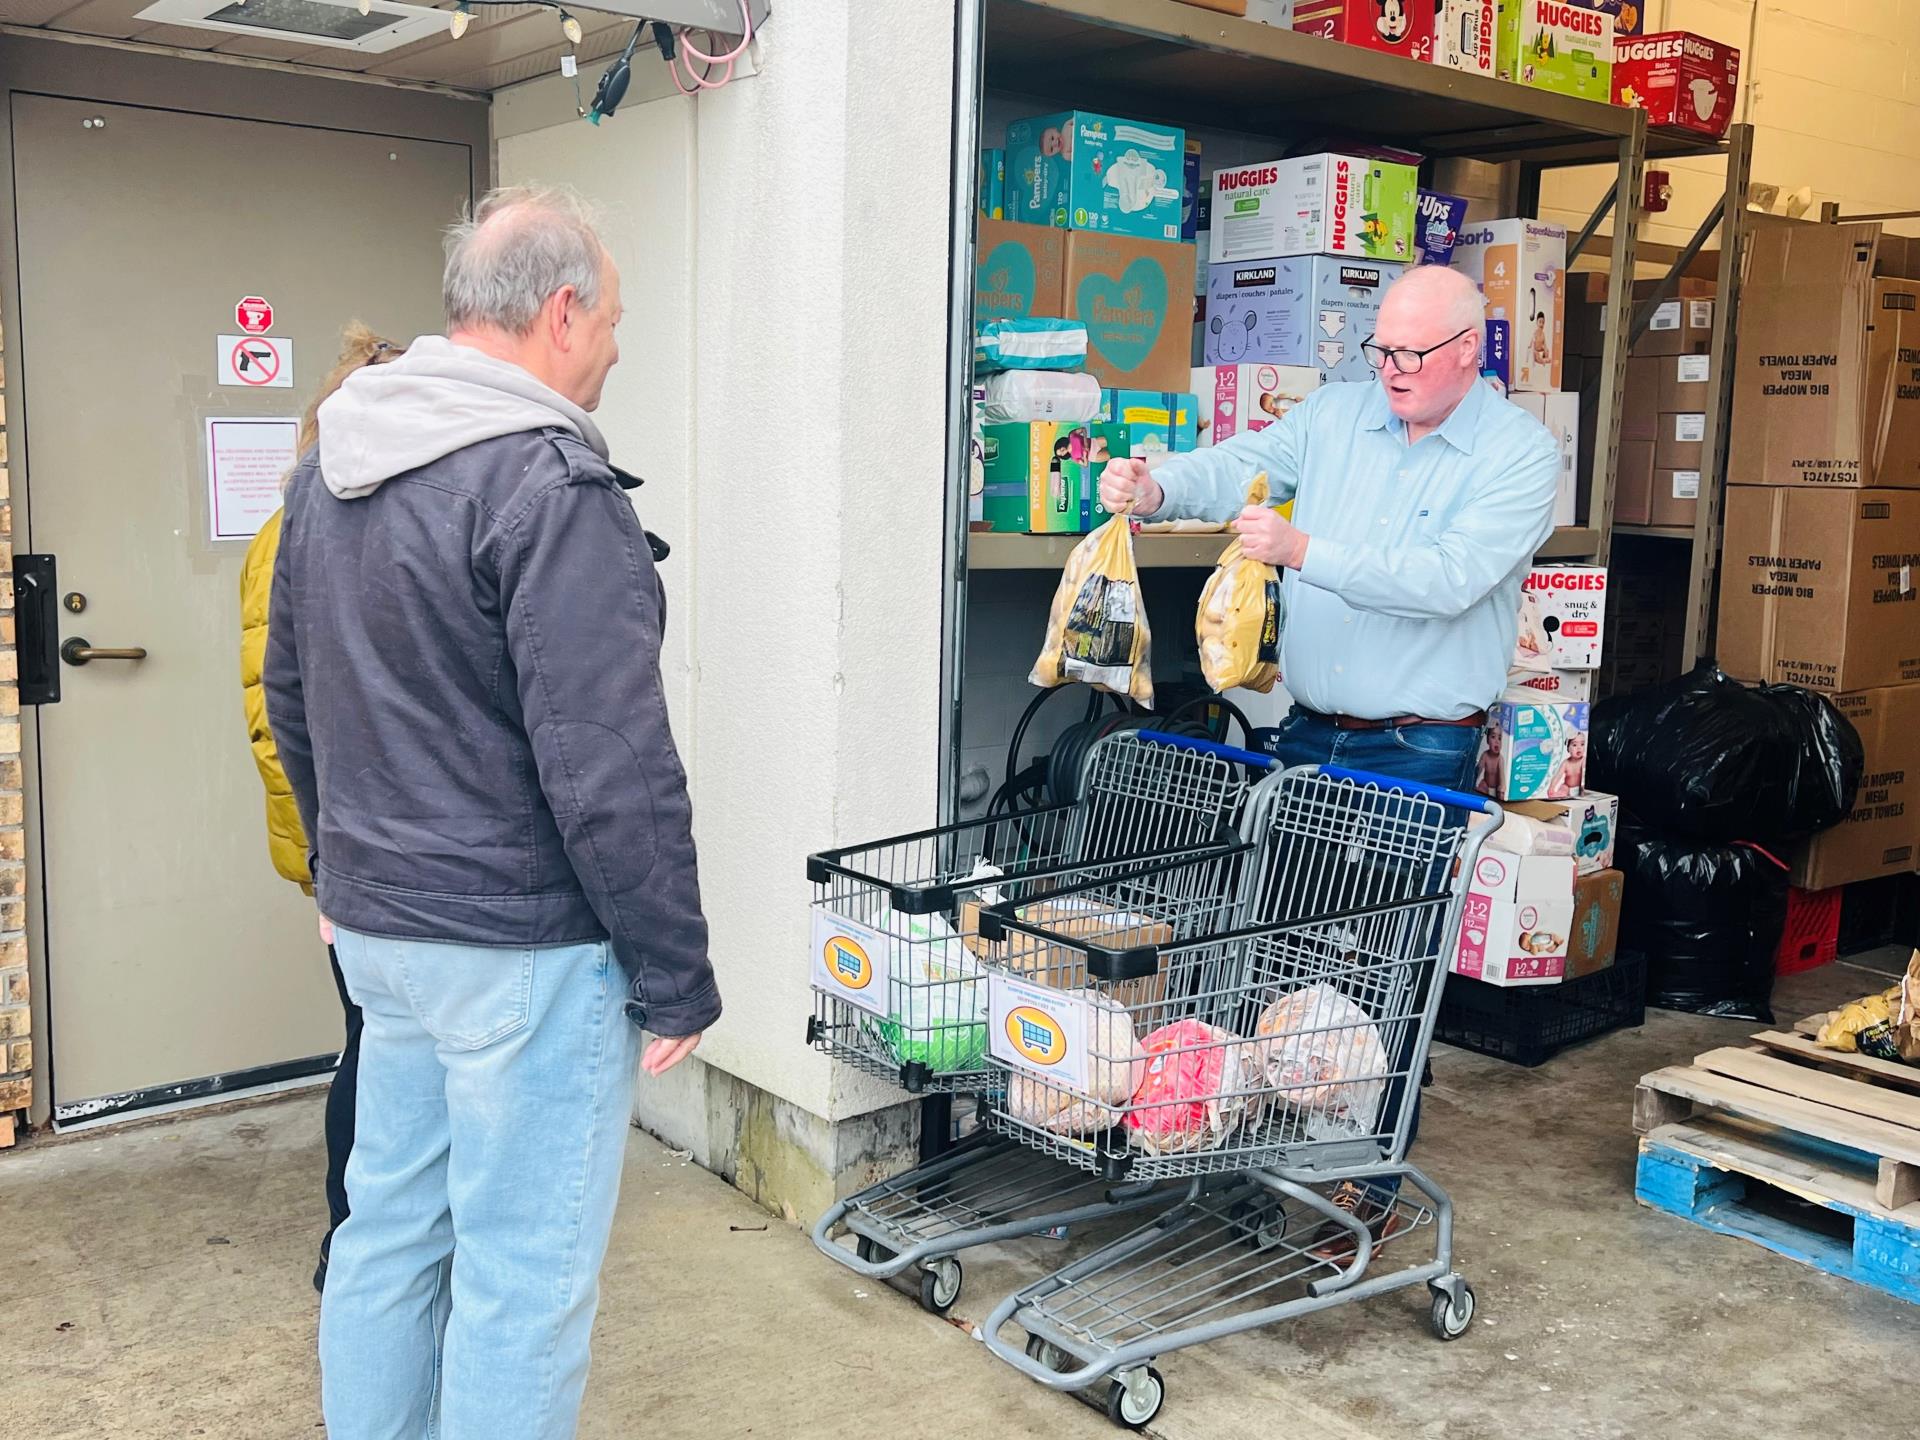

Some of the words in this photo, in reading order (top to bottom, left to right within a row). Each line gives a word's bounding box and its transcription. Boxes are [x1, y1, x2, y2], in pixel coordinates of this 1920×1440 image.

[1536, 1, 1602, 36] HUGGIES
[1324, 20, 1335, 39] 2
[1479, 0, 1493, 70] GGIES
[1421, 35, 1430, 54] 2
[1684, 38, 1714, 61] HUGGIES
[1080, 124, 1107, 141] Pampers
[1029, 155, 1042, 209] Pampers
[1219, 167, 1278, 192] HUGGIES
[1224, 188, 1252, 201] natural
[1253, 187, 1271, 197] care
[1333, 160, 1349, 250] HUGGIES
[1417, 194, 1452, 221] -Ups
[1426, 221, 1450, 236] plus
[1456, 227, 1494, 247] sorb
[1235, 269, 1275, 282] KIRKLAND
[1342, 268, 1379, 281] KIRKLAND
[1494, 261, 1506, 278] 4
[1216, 289, 1238, 300] diapers
[1241, 289, 1266, 299] couches
[1321, 298, 1344, 308] diapers
[1092, 294, 1155, 328] Pampers
[1759, 354, 1800, 366] TOWELS
[1802, 355, 1837, 366] PAPER
[1780, 369, 1812, 380] MEGA
[1762, 383, 1808, 395] MOPPER
[1810, 384, 1829, 395] BIG
[1032, 423, 1041, 452] PACK
[1032, 455, 1041, 470] UP
[1802, 469, 1858, 482] TC5747C1
[1032, 474, 1041, 511] STOCK
[1058, 478, 1067, 511] Depend
[1748, 555, 1787, 568] TOWELS
[1789, 557, 1821, 570] PAPER
[1524, 572, 1605, 591] HUGGIES
[1769, 571, 1798, 582] MEGA
[1752, 584, 1793, 597] MOPPER
[1796, 587, 1814, 599] BIG
[1564, 600, 1588, 611] snug
[1590, 601, 1598, 609] &
[1571, 609, 1589, 620] dry
[1786, 671, 1836, 687] TC5747C1
[1871, 771, 1905, 787] MOPPER
[1865, 789, 1889, 804] MEGA
[1874, 803, 1905, 819] TOWELS
